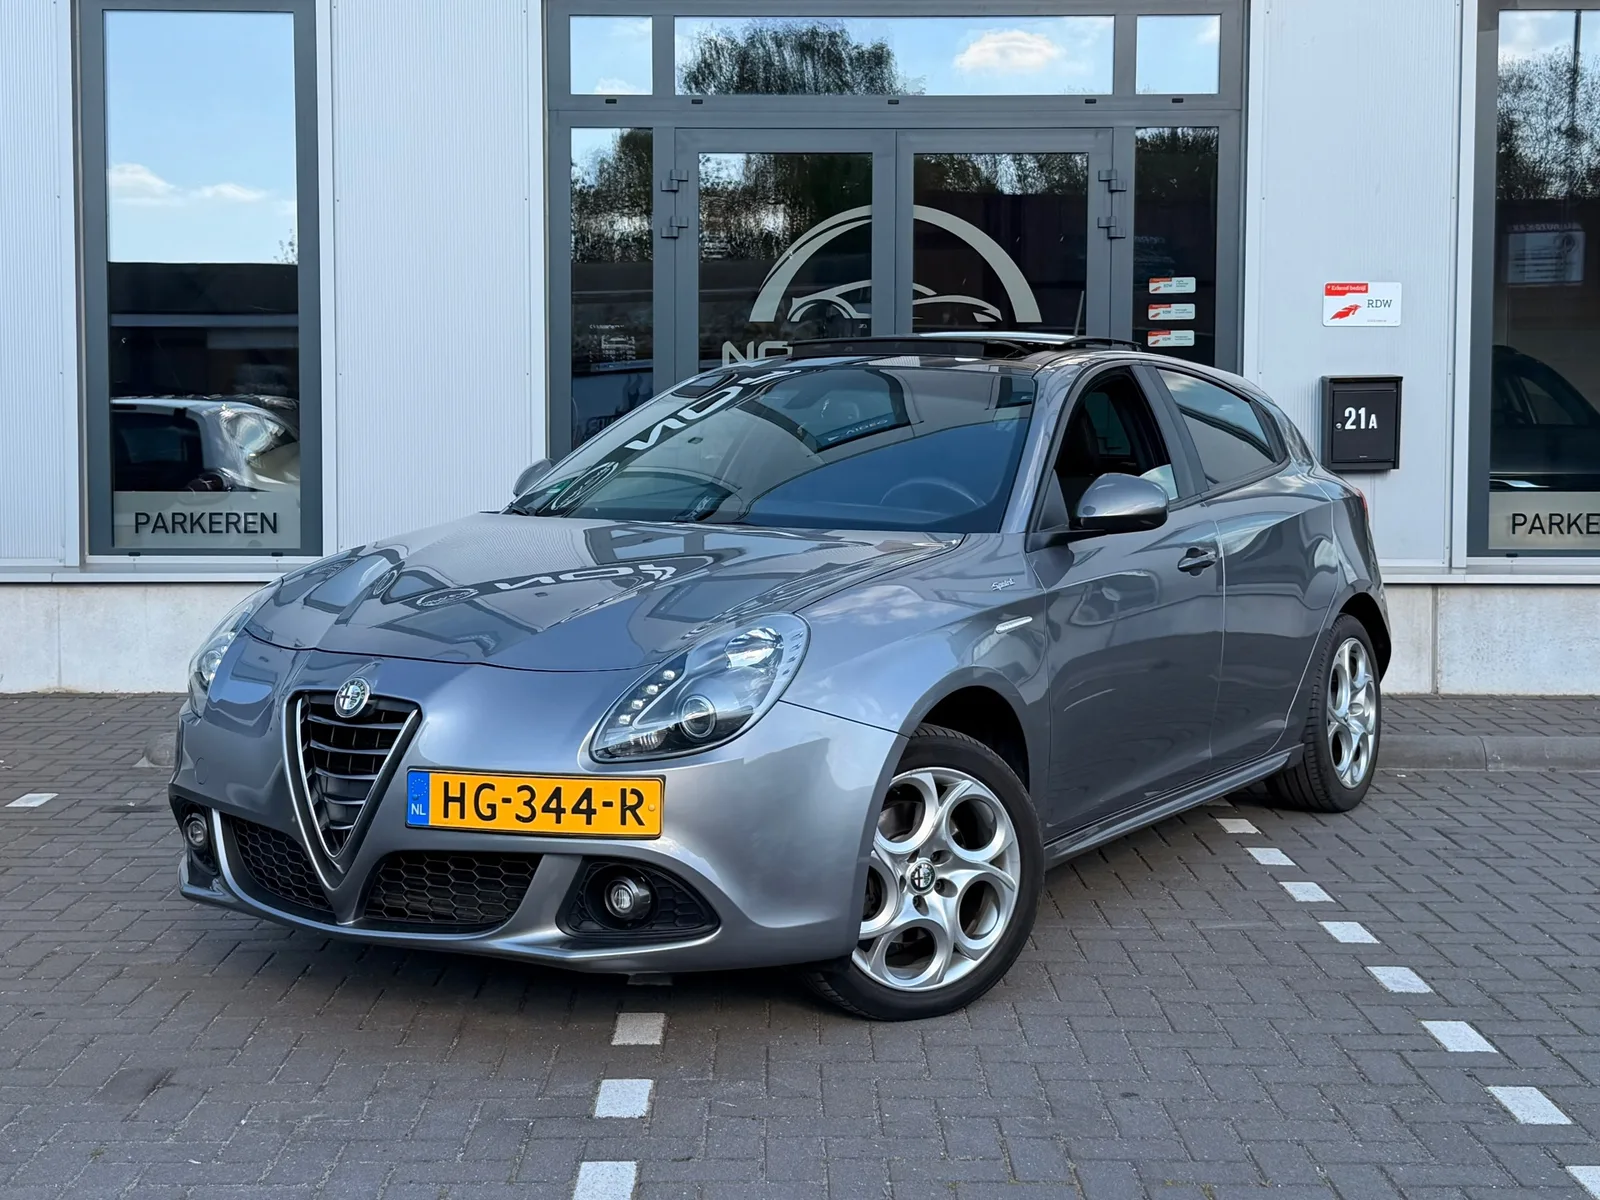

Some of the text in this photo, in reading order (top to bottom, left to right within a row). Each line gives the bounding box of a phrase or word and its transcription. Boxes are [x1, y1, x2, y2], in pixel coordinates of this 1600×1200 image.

[1367, 299, 1392, 308] RDW
[135, 512, 277, 534] PARKEREN
[1511, 513, 1600, 535] PARKE
[411, 803, 426, 817] NL
[443, 781, 645, 827] HG-344-R
